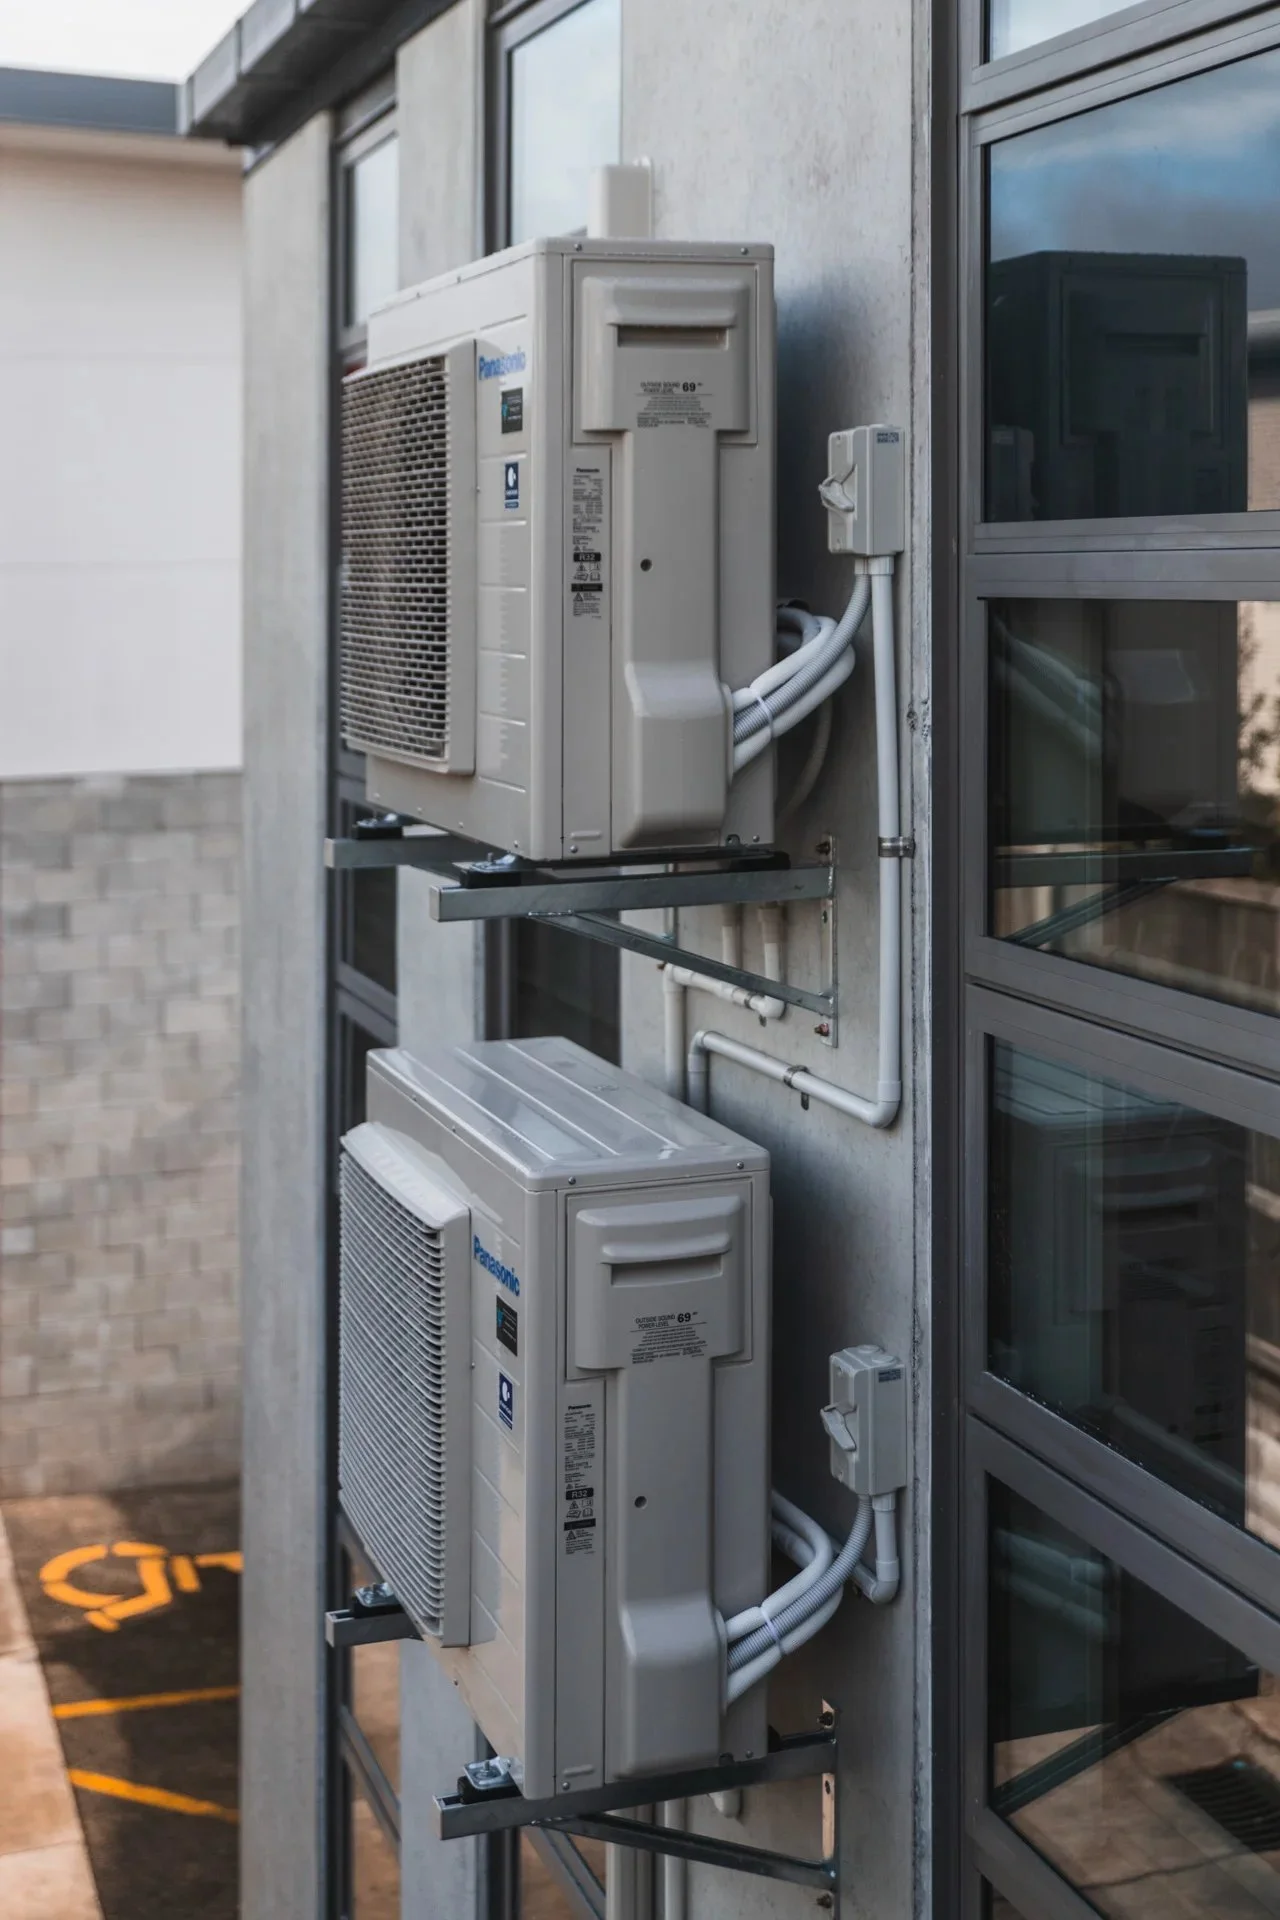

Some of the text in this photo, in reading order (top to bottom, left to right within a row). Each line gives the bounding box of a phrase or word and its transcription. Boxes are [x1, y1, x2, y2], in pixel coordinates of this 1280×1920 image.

[478, 348, 526, 381] Panasonic
[682, 382, 696, 392] 69
[473, 1235, 520, 1297] Panasonic
[677, 1312, 691, 1323] 69
[571, 1489, 588, 1499] R32
